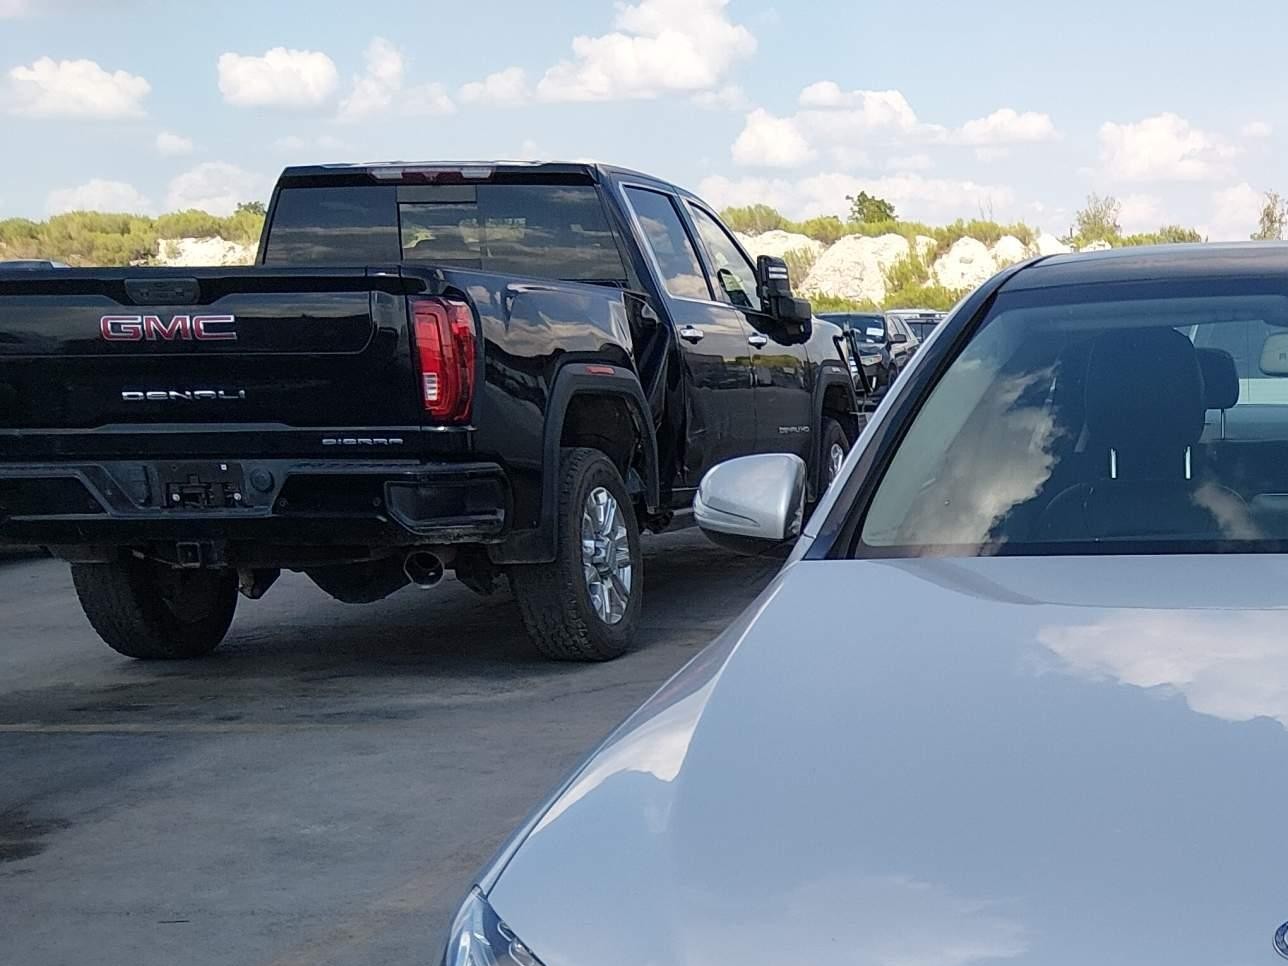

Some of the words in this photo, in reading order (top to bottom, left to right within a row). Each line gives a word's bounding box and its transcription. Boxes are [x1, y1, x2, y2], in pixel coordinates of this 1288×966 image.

[100, 315, 238, 342] GMC
[121, 389, 246, 401] DENALI
[322, 438, 404, 446] SIERRA
